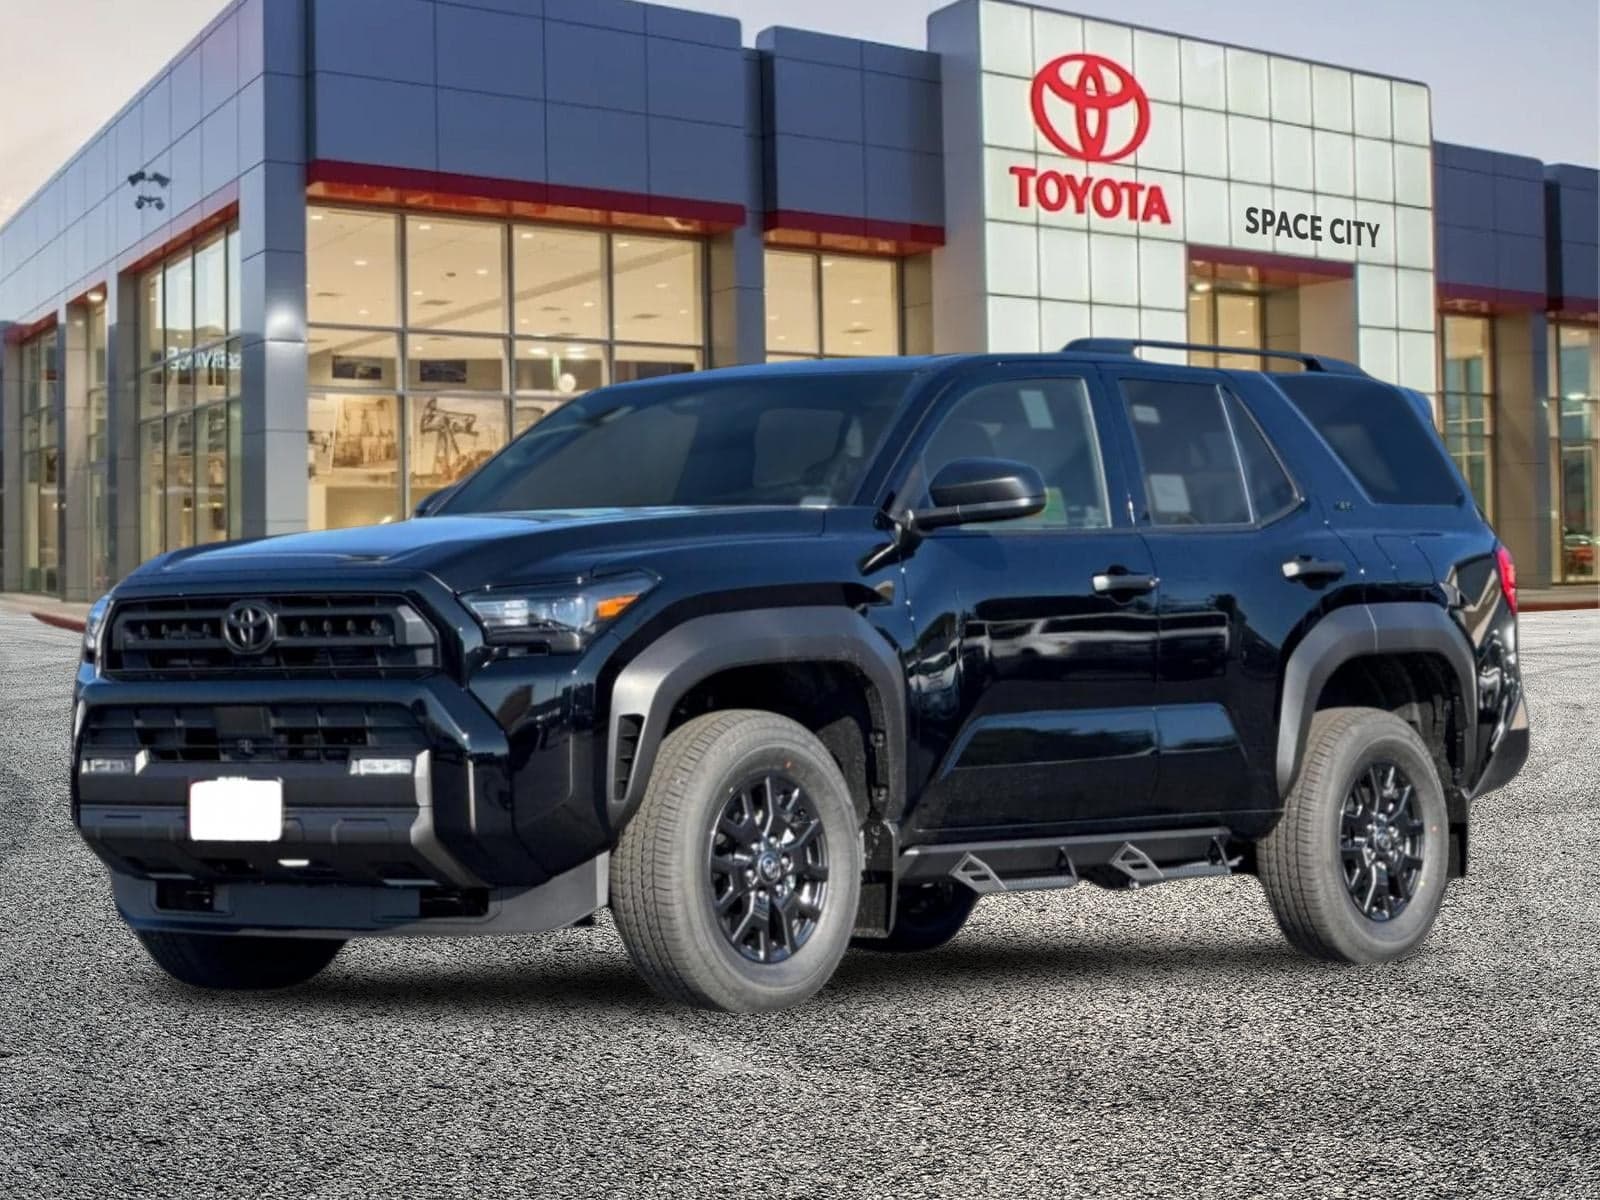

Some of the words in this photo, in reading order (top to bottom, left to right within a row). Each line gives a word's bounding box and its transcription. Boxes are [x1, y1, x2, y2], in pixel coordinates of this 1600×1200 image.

[1009, 166, 1171, 224] TOYOTA
[1245, 206, 1322, 241] SPACE
[1329, 218, 1381, 248] CITY
